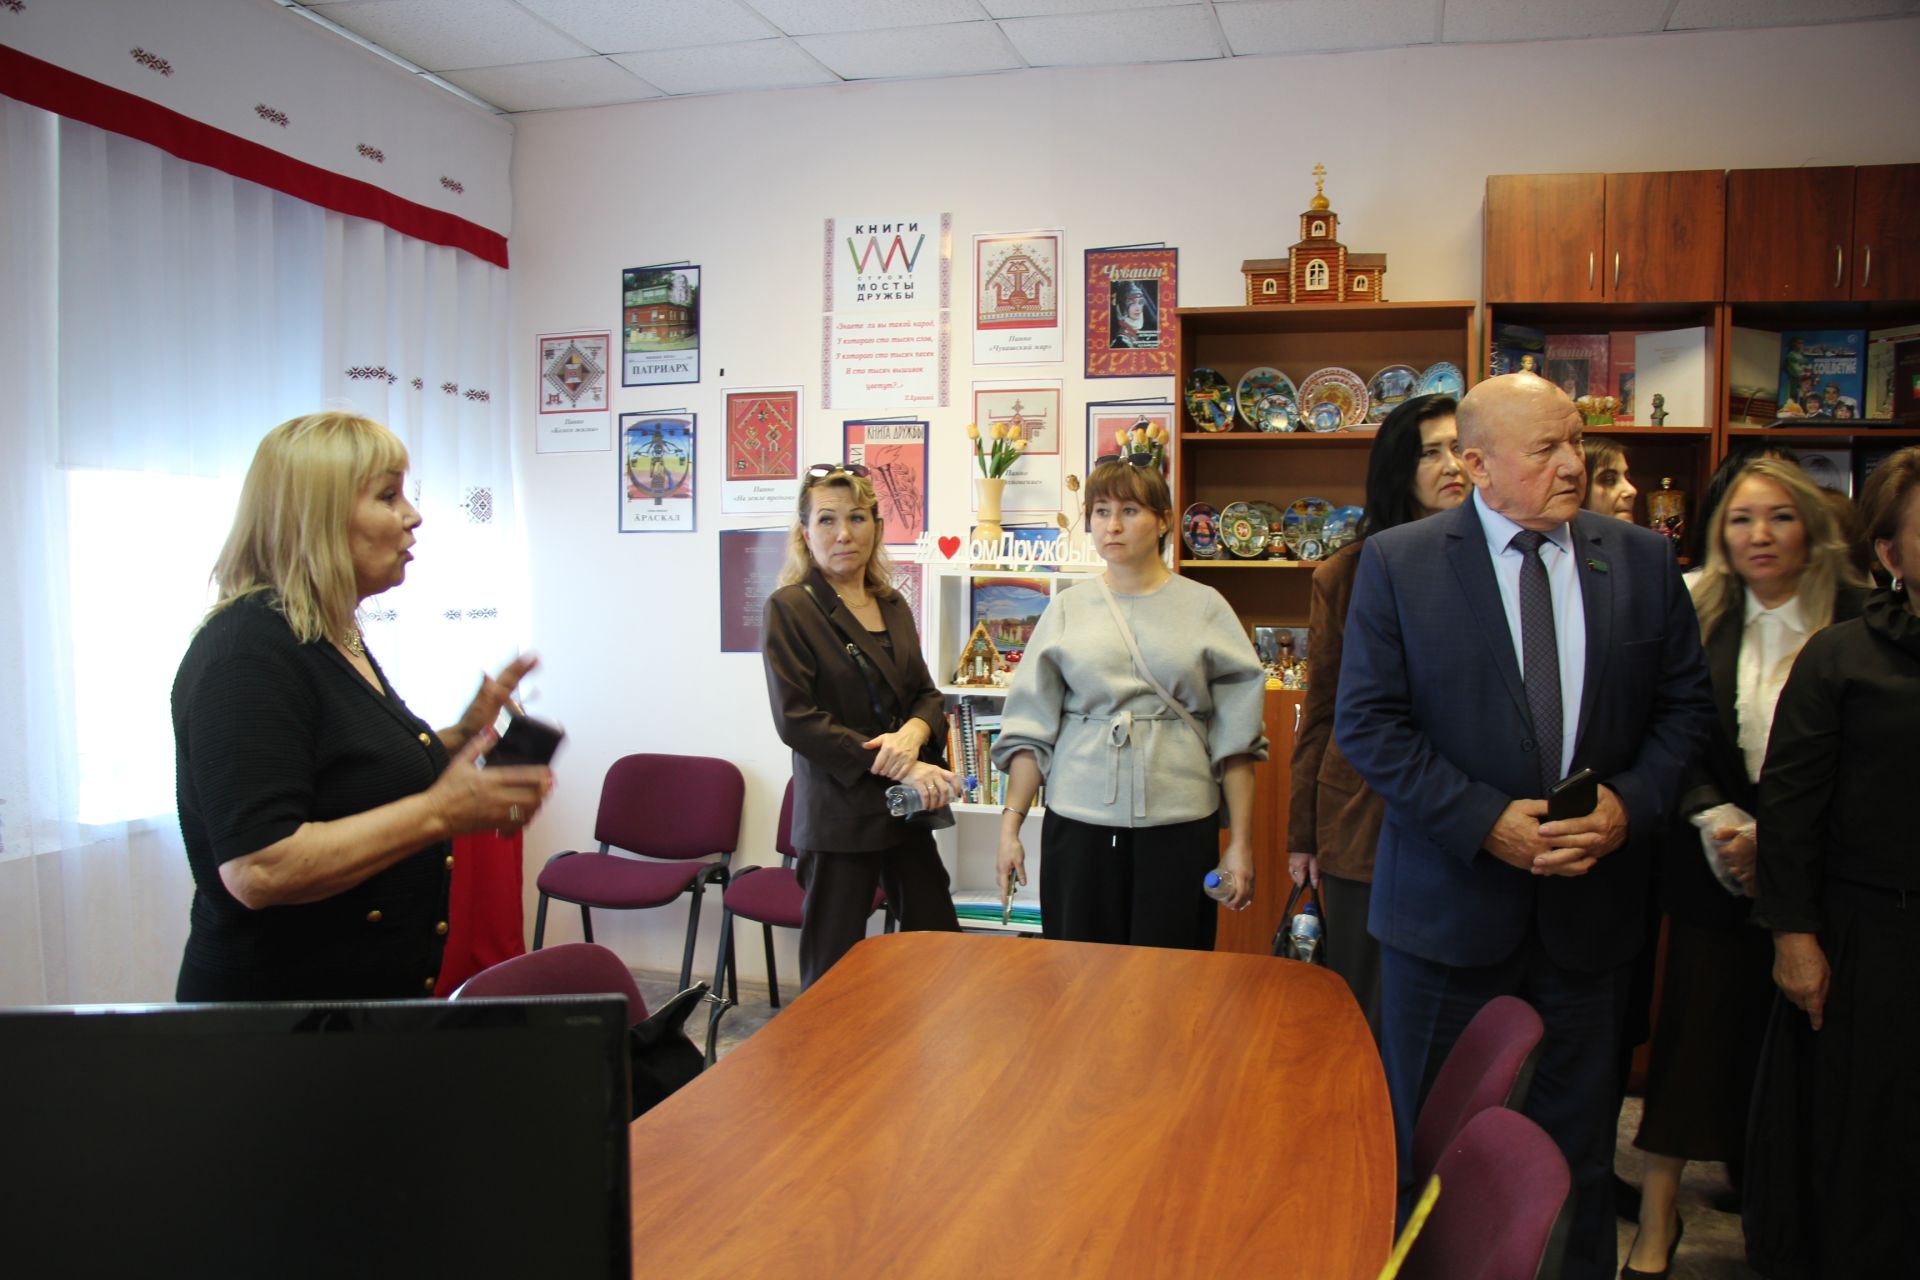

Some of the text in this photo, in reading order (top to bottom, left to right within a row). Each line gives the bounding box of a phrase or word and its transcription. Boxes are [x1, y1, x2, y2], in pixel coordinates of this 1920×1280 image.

[855, 222, 918, 234] КНИГИ
[1104, 263, 1163, 282] Чуваши
[857, 282, 914, 291] МОСТЫ
[857, 292, 914, 302] ДРУЖБЫ
[631, 363, 690, 375] ПАТРИАРХ
[867, 425, 924, 439] КНИГА ДРУЖБЫ
